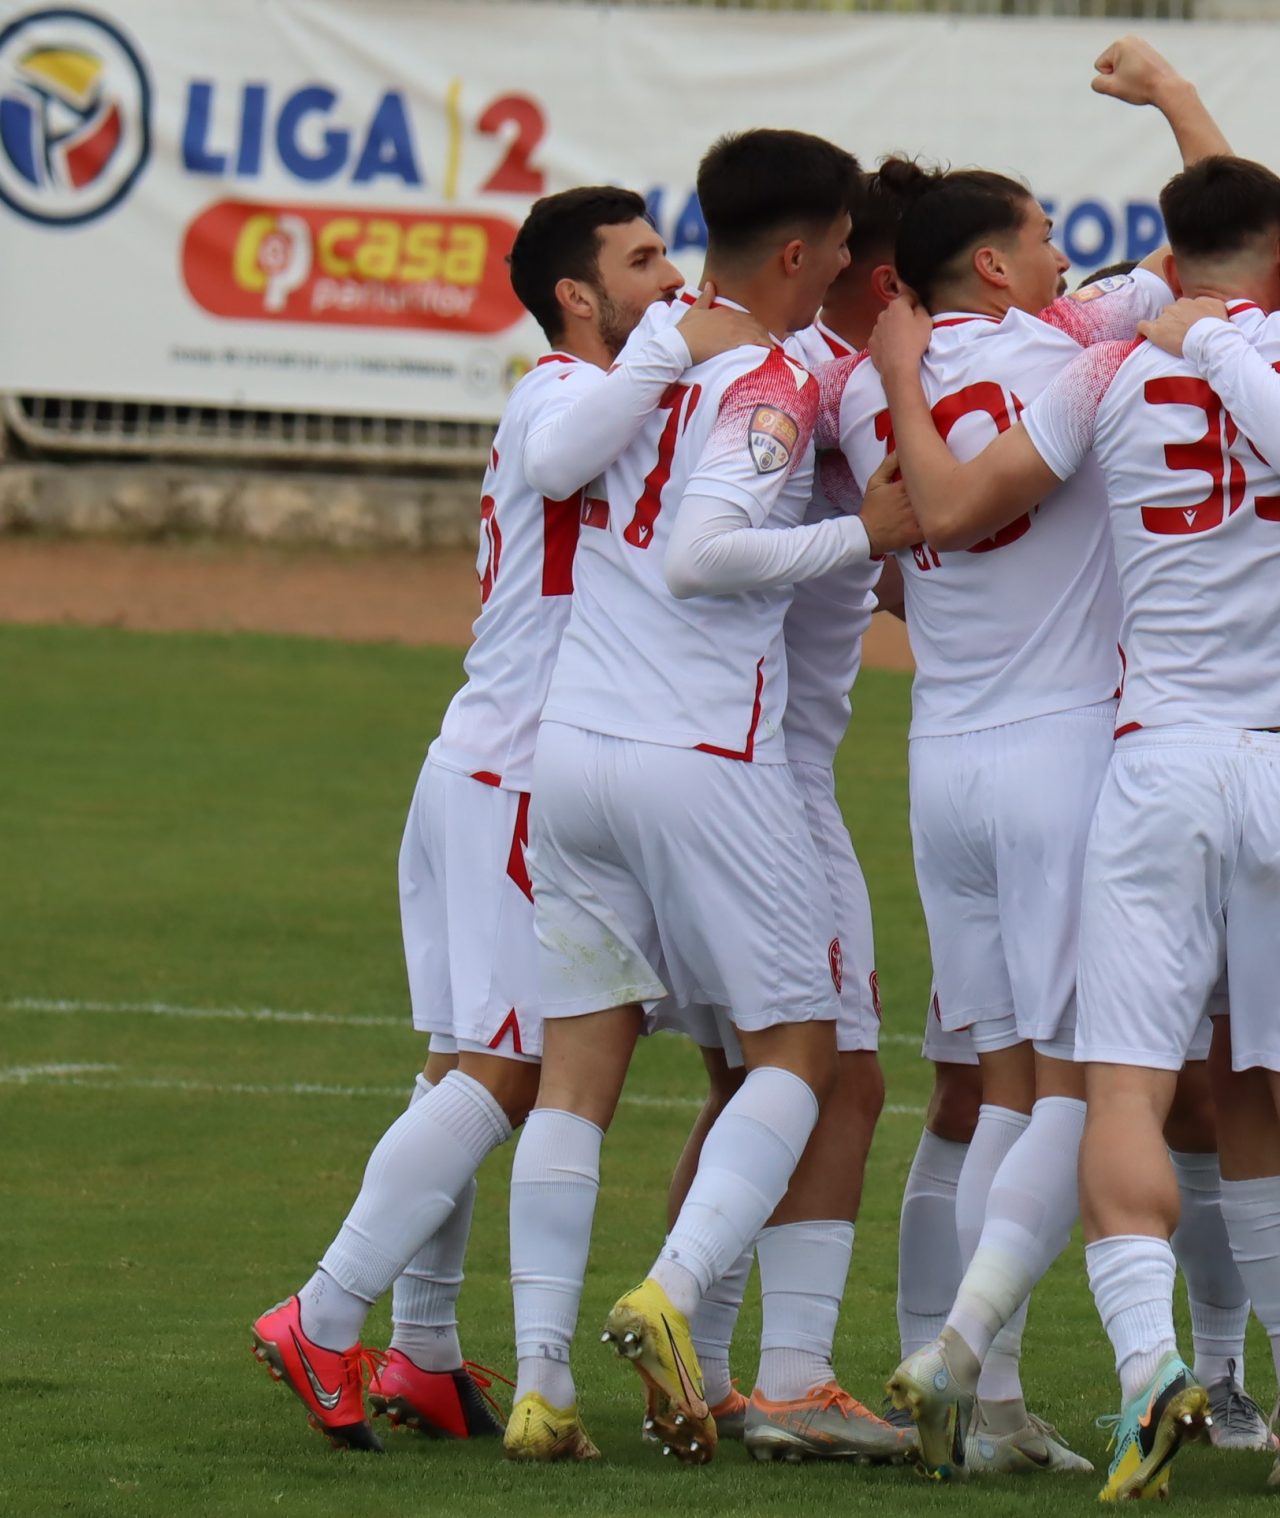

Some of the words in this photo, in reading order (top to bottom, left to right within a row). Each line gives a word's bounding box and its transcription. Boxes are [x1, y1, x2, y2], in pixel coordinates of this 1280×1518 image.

[181, 81, 422, 186] LIGA
[476, 92, 546, 193] 2
[318, 217, 489, 285] casa
